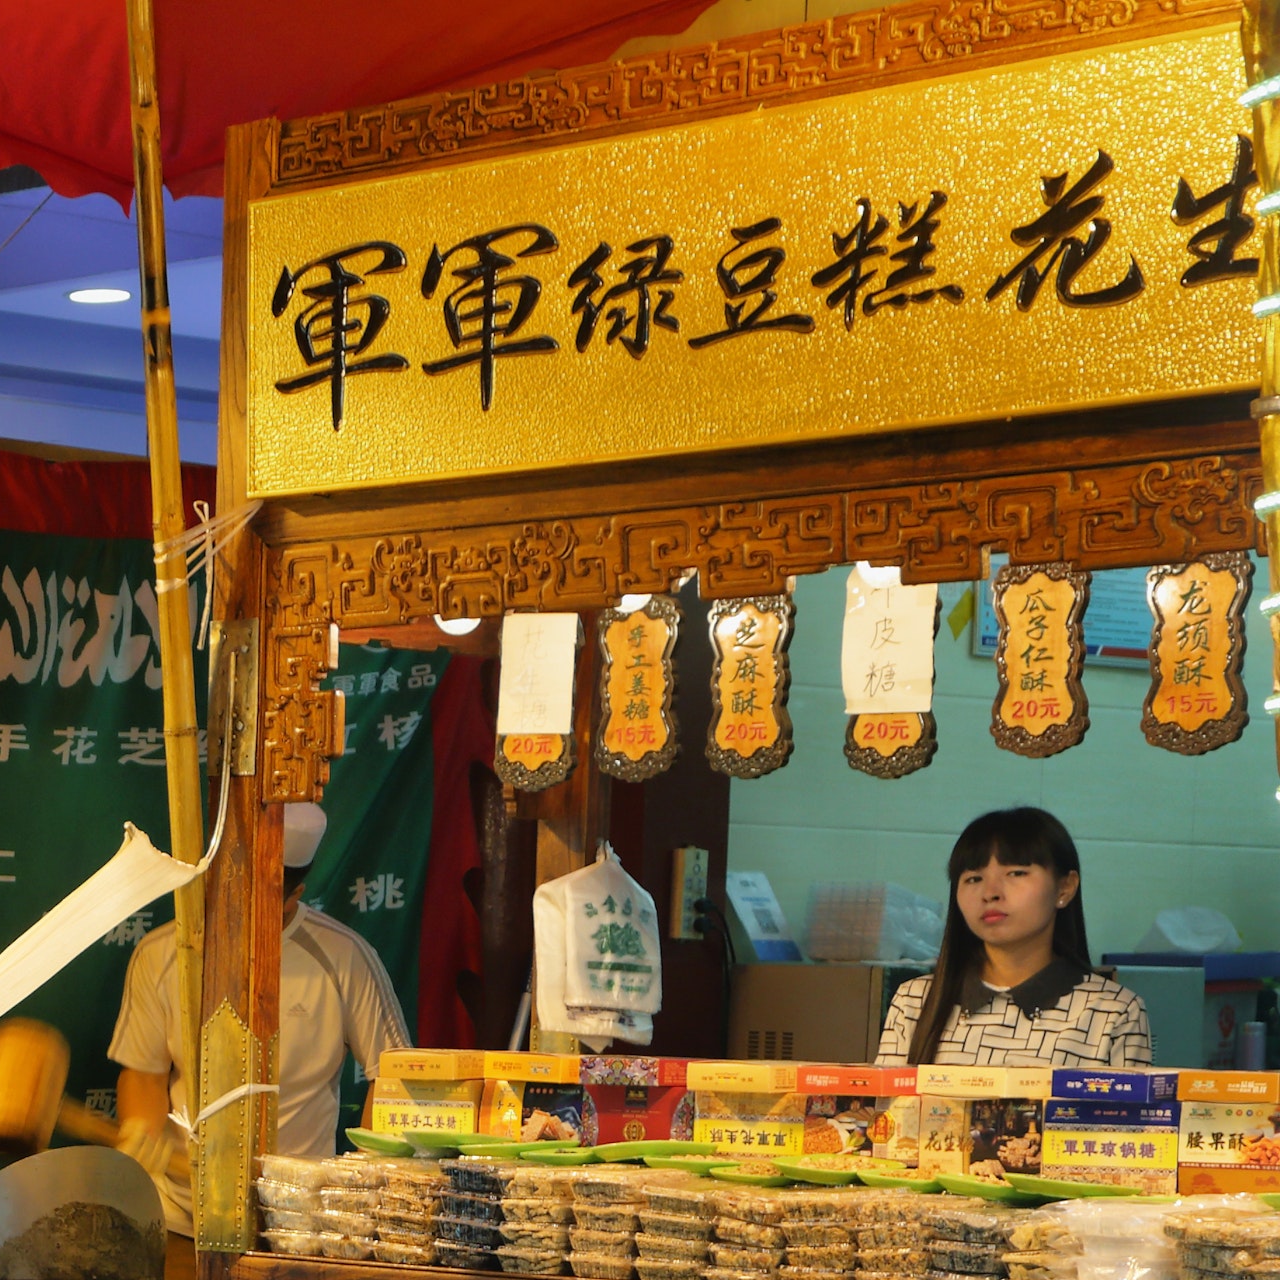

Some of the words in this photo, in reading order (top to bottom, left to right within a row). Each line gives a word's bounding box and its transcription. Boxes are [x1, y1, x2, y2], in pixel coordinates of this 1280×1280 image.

[1019, 586, 1058, 694] 瓜子仁酥
[1173, 579, 1214, 688] 龙须酥
[730, 618, 766, 718] 芝麻酥
[1011, 697, 1061, 721] 20元
[1166, 692, 1219, 716] 15元
[614, 723, 656, 746] 15元
[724, 721, 768, 743] 20元
[862, 718, 911, 743] 20元
[511, 735, 553, 756] 20元
[1186, 1130, 1248, 1151] 腰果酥
